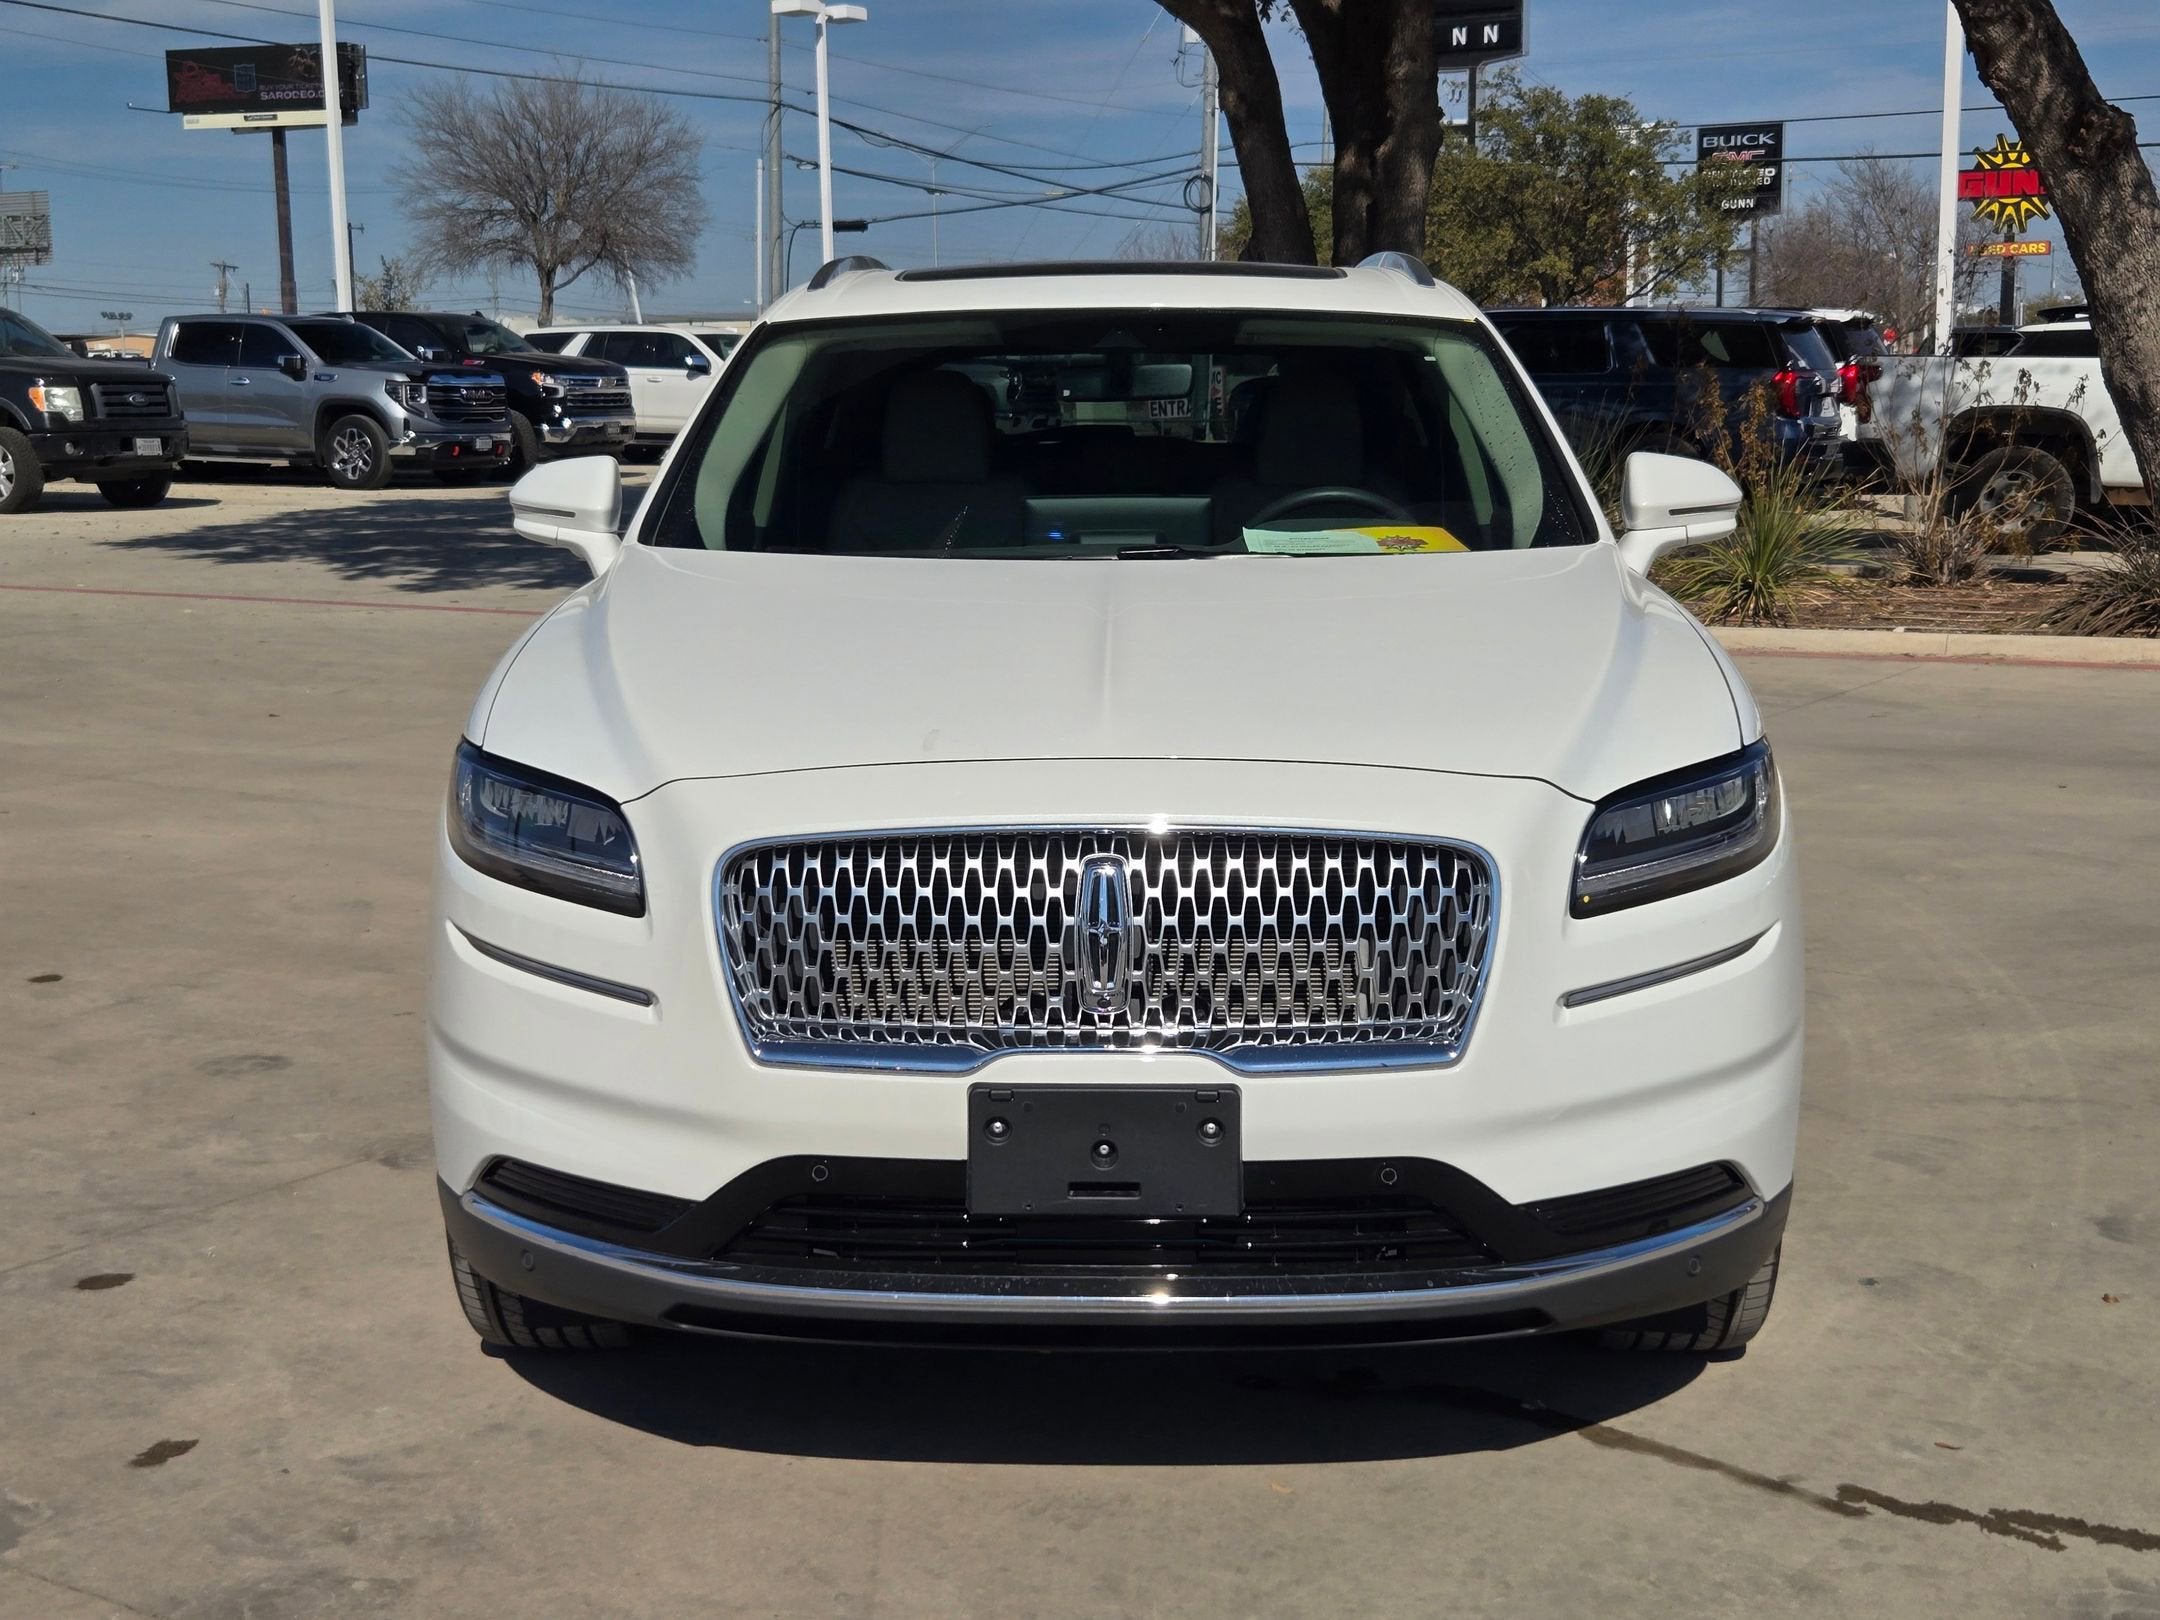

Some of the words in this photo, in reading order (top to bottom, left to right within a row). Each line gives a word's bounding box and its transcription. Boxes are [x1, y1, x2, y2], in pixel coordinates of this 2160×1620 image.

[1702, 132, 1776, 148] BUICK
[1958, 169, 2046, 198] GUN
[1721, 198, 1754, 209] GUNN
[2009, 242, 2046, 254] CARS
[1150, 401, 1192, 417] ENTRA
